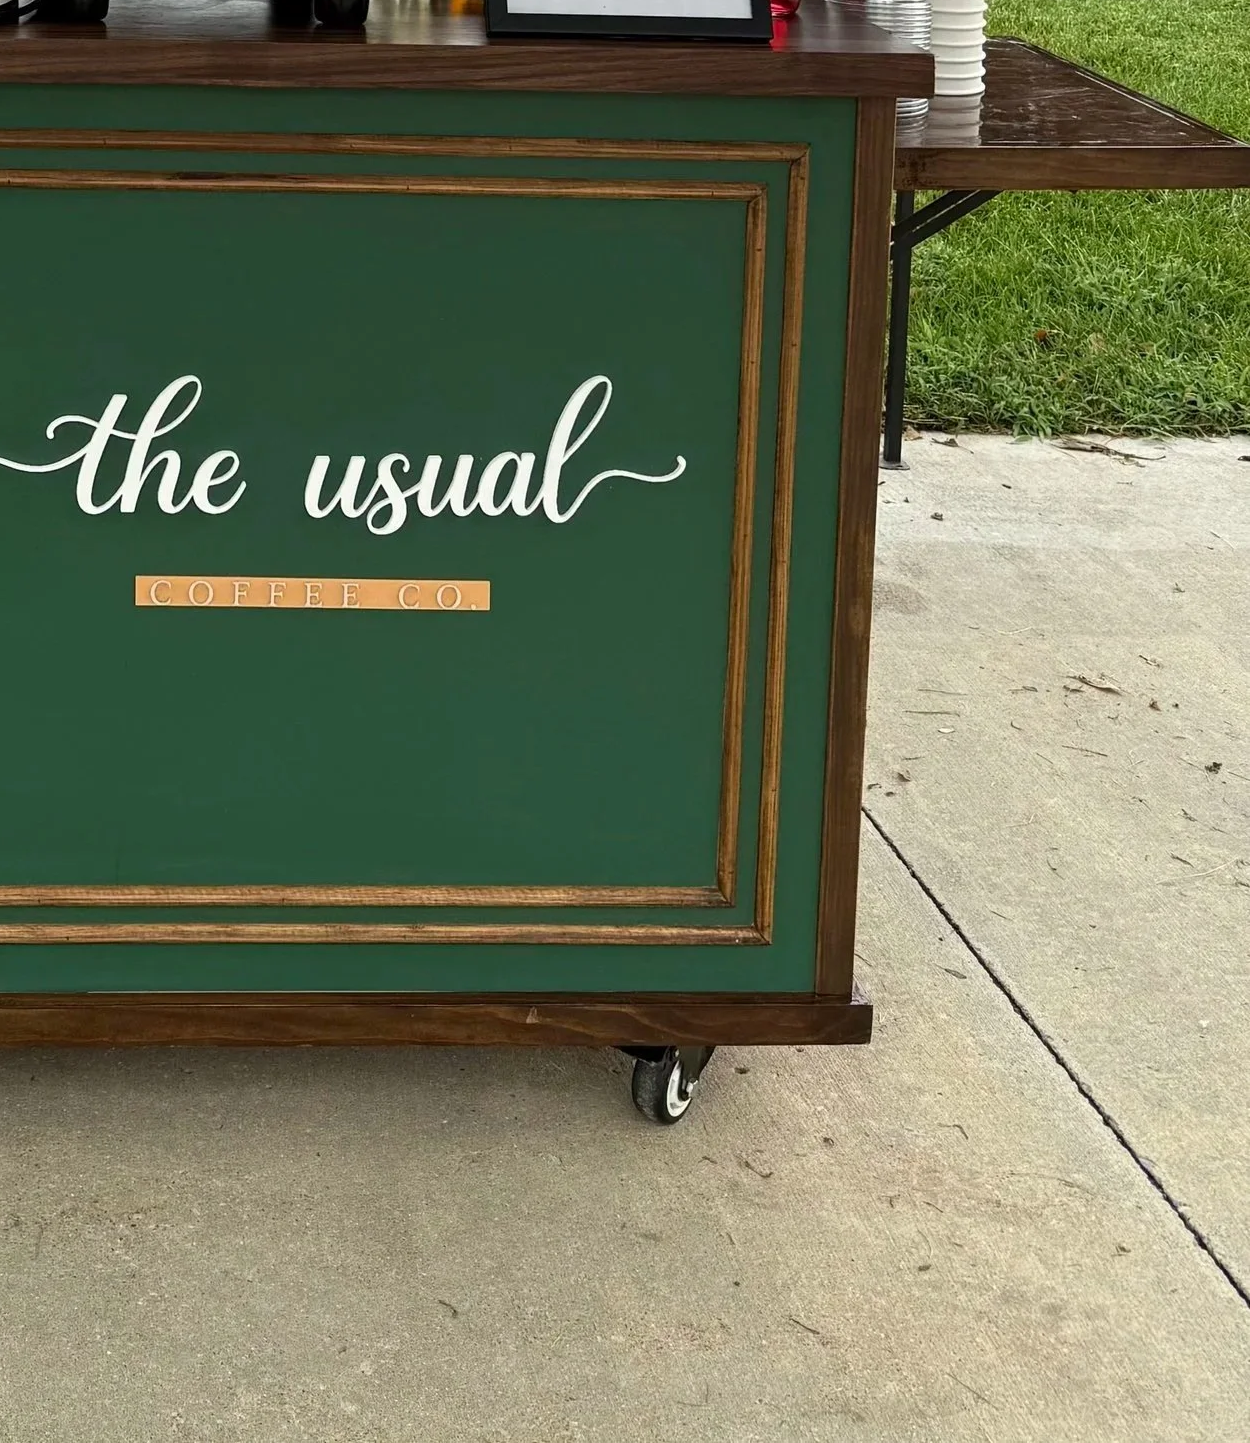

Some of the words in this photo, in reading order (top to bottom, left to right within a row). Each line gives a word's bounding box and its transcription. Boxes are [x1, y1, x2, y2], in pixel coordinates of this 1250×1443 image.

[303, 374, 688, 536] usual
[148, 579, 363, 609] COFFEE
[396, 582, 480, 612] CO.
